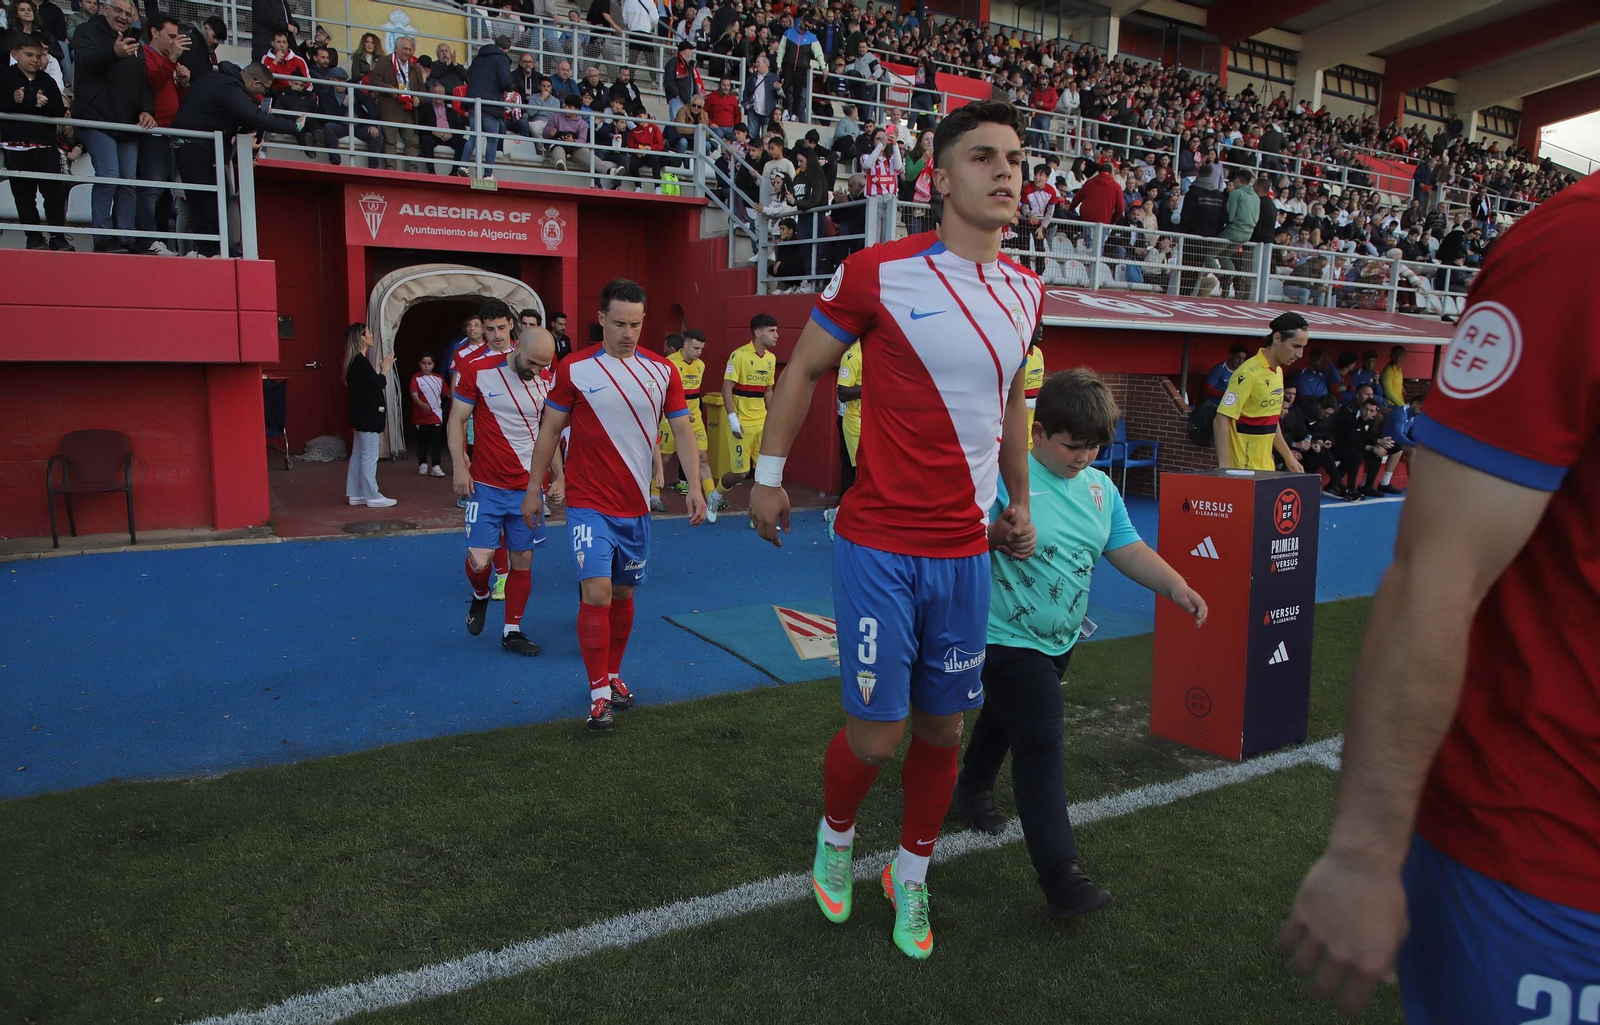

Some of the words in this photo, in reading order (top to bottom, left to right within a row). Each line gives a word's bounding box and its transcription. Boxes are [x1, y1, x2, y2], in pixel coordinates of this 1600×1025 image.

[472, 180, 495, 188] SALIDA
[399, 203, 505, 222] ALGECIRAS
[508, 211, 532, 224] CF
[403, 224, 466, 237] Ayuntamiento
[467, 228, 479, 238] de
[480, 229, 528, 241] Algeciras
[1462, 325, 1501, 349] RF
[1451, 348, 1489, 372] EF
[735, 444, 743, 457] 9
[1191, 499, 1233, 514] VERSUS
[1195, 510, 1229, 519] E-LEARNING
[573, 523, 593, 551] 24
[1271, 537, 1299, 555] PRIMERA
[1271, 551, 1299, 560] FEDERACIÓN
[1275, 558, 1299, 568] VERSUS
[1270, 605, 1300, 620] VERSUS
[858, 616, 878, 665] 3
